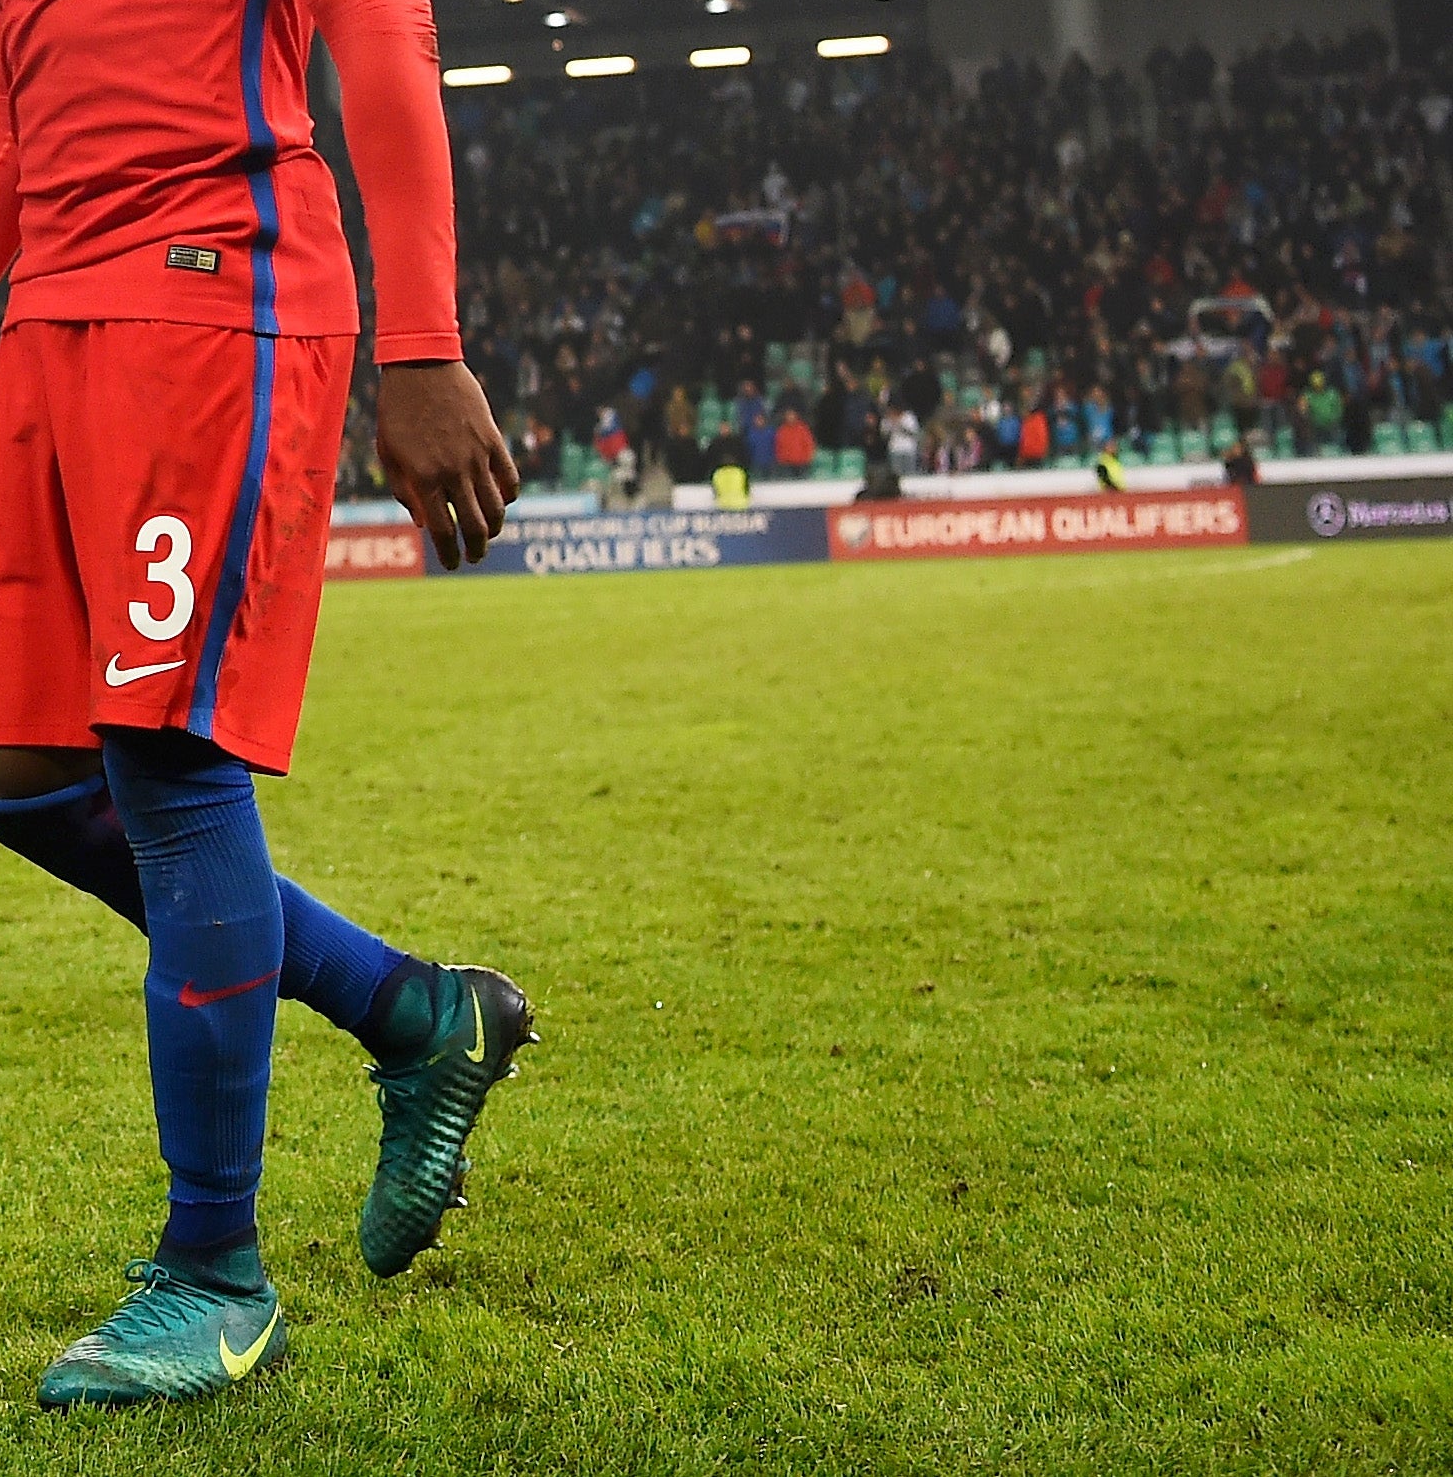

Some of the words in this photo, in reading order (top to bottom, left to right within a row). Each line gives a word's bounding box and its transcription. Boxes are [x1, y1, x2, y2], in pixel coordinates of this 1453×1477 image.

[873, 509, 1046, 548] EUROPEAN
[1051, 500, 1241, 541] QUALIFIERS
[1347, 499, 1450, 528] Mercedes
[325, 535, 418, 568] FIERS
[523, 536, 721, 575] QUALIFIERS
[128, 515, 195, 641] 3
